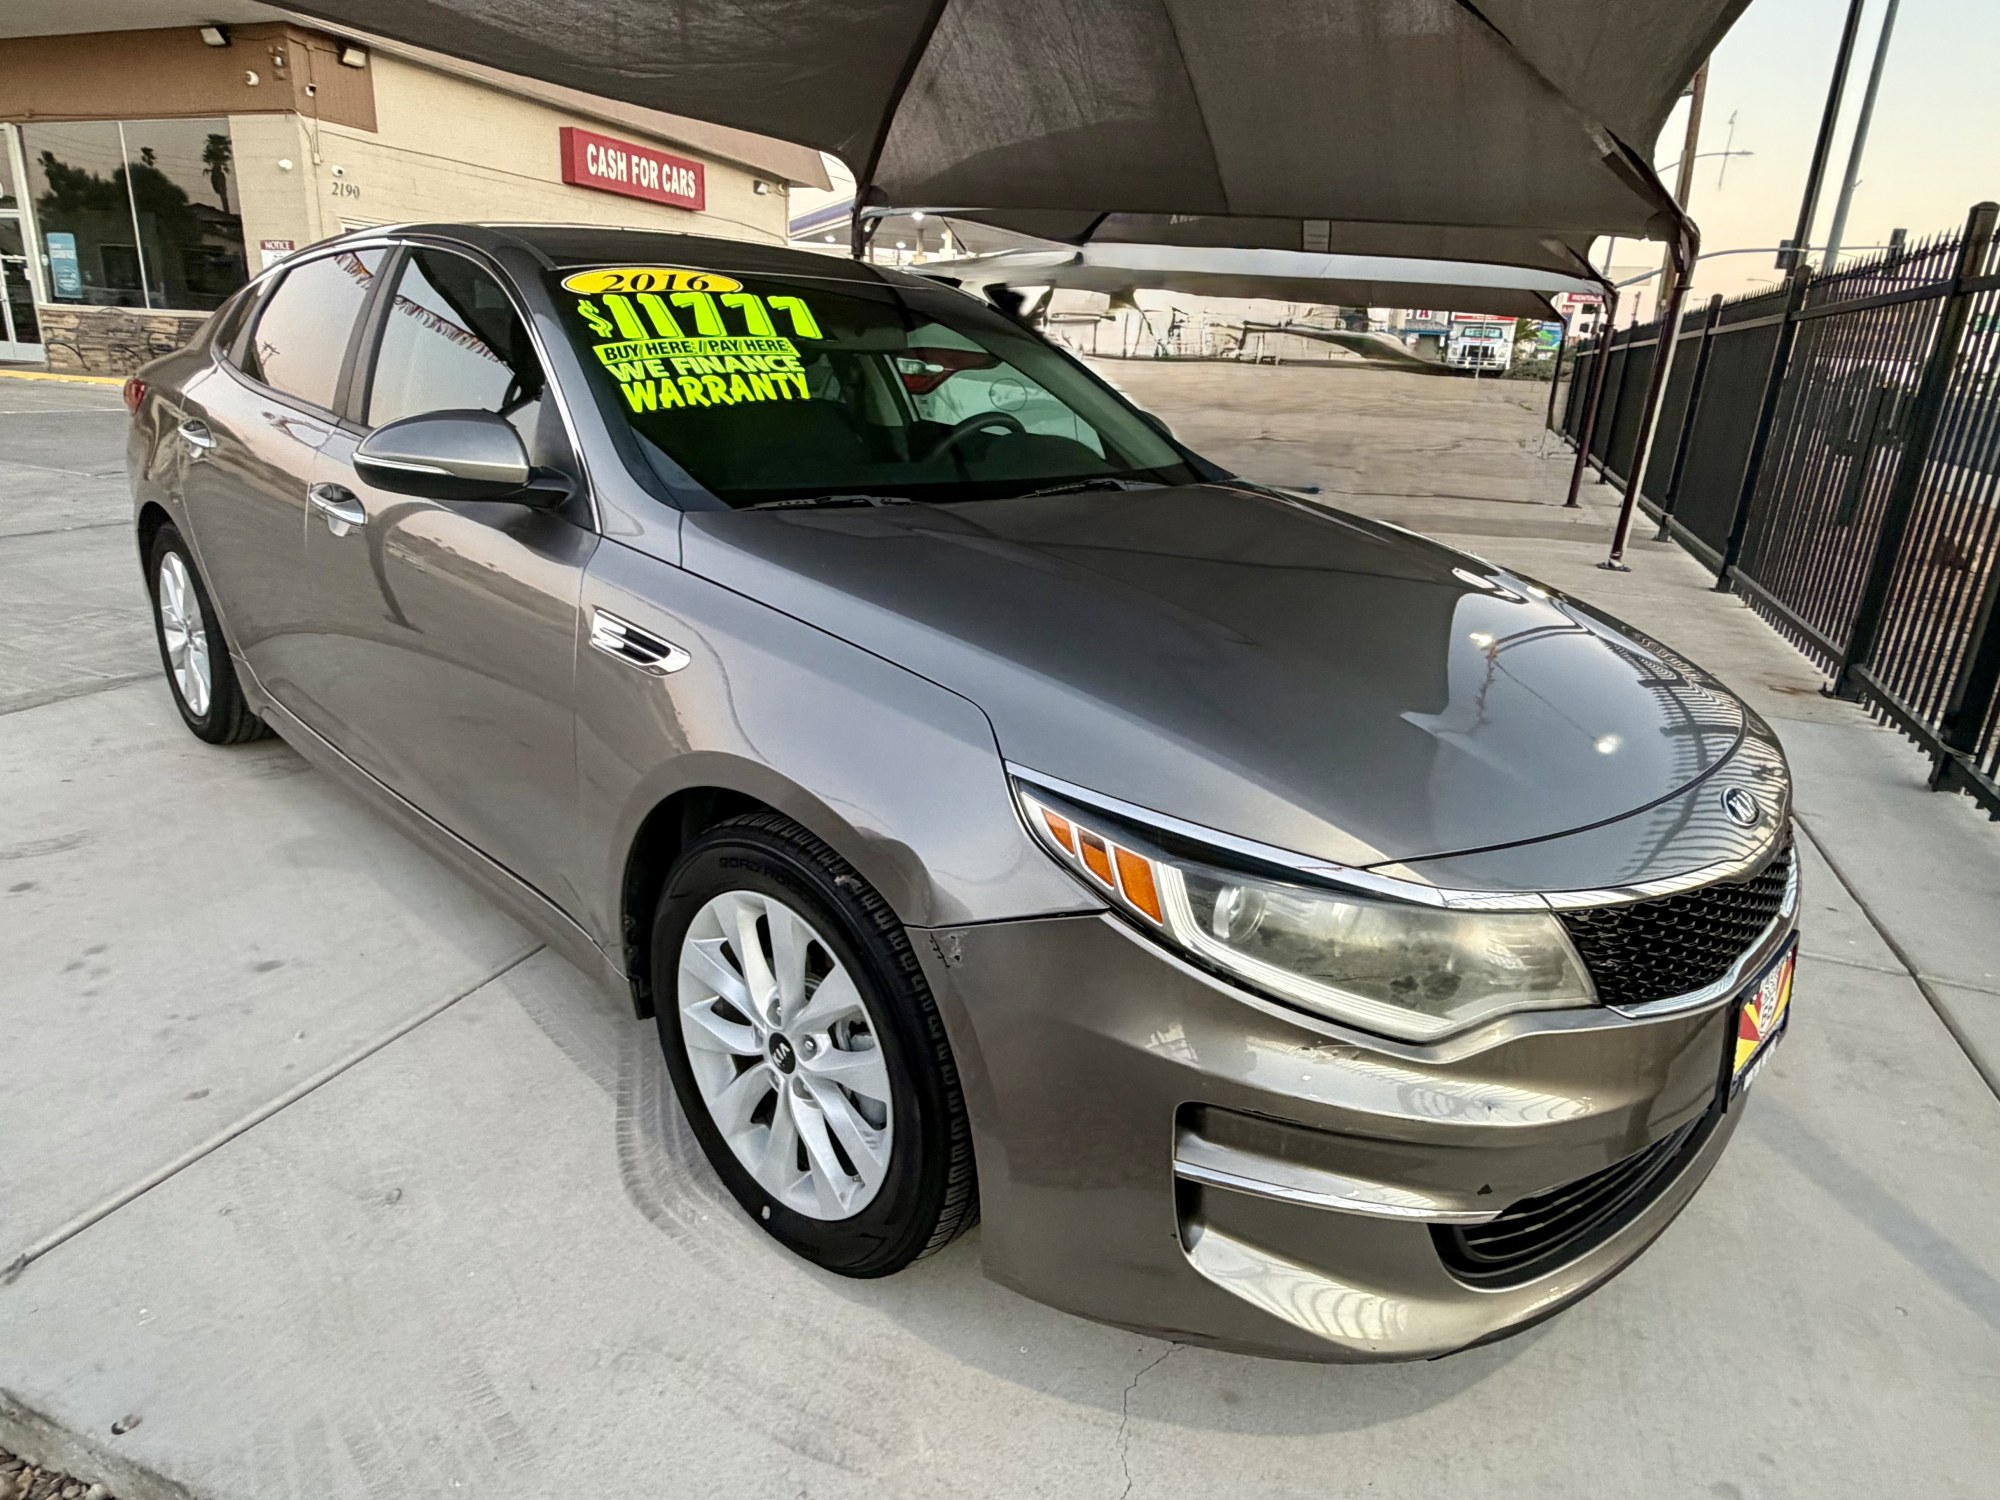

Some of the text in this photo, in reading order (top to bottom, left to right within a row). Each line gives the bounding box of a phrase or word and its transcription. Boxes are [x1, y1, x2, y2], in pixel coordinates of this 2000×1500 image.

[587, 143, 696, 198] CASH FOR CARS
[331, 182, 360, 199] 2190
[264, 241, 290, 250] NOTICE
[600, 273, 710, 292] 2016
[577, 291, 823, 339] $11777
[603, 344, 642, 361] BUY
[645, 340, 693, 355] HERE
[709, 340, 742, 353] PAY
[743, 338, 787, 352] HERE
[605, 354, 806, 382] WE FINANCE
[620, 372, 812, 413] WARRANTY
[772, 1042, 790, 1067] KIA
